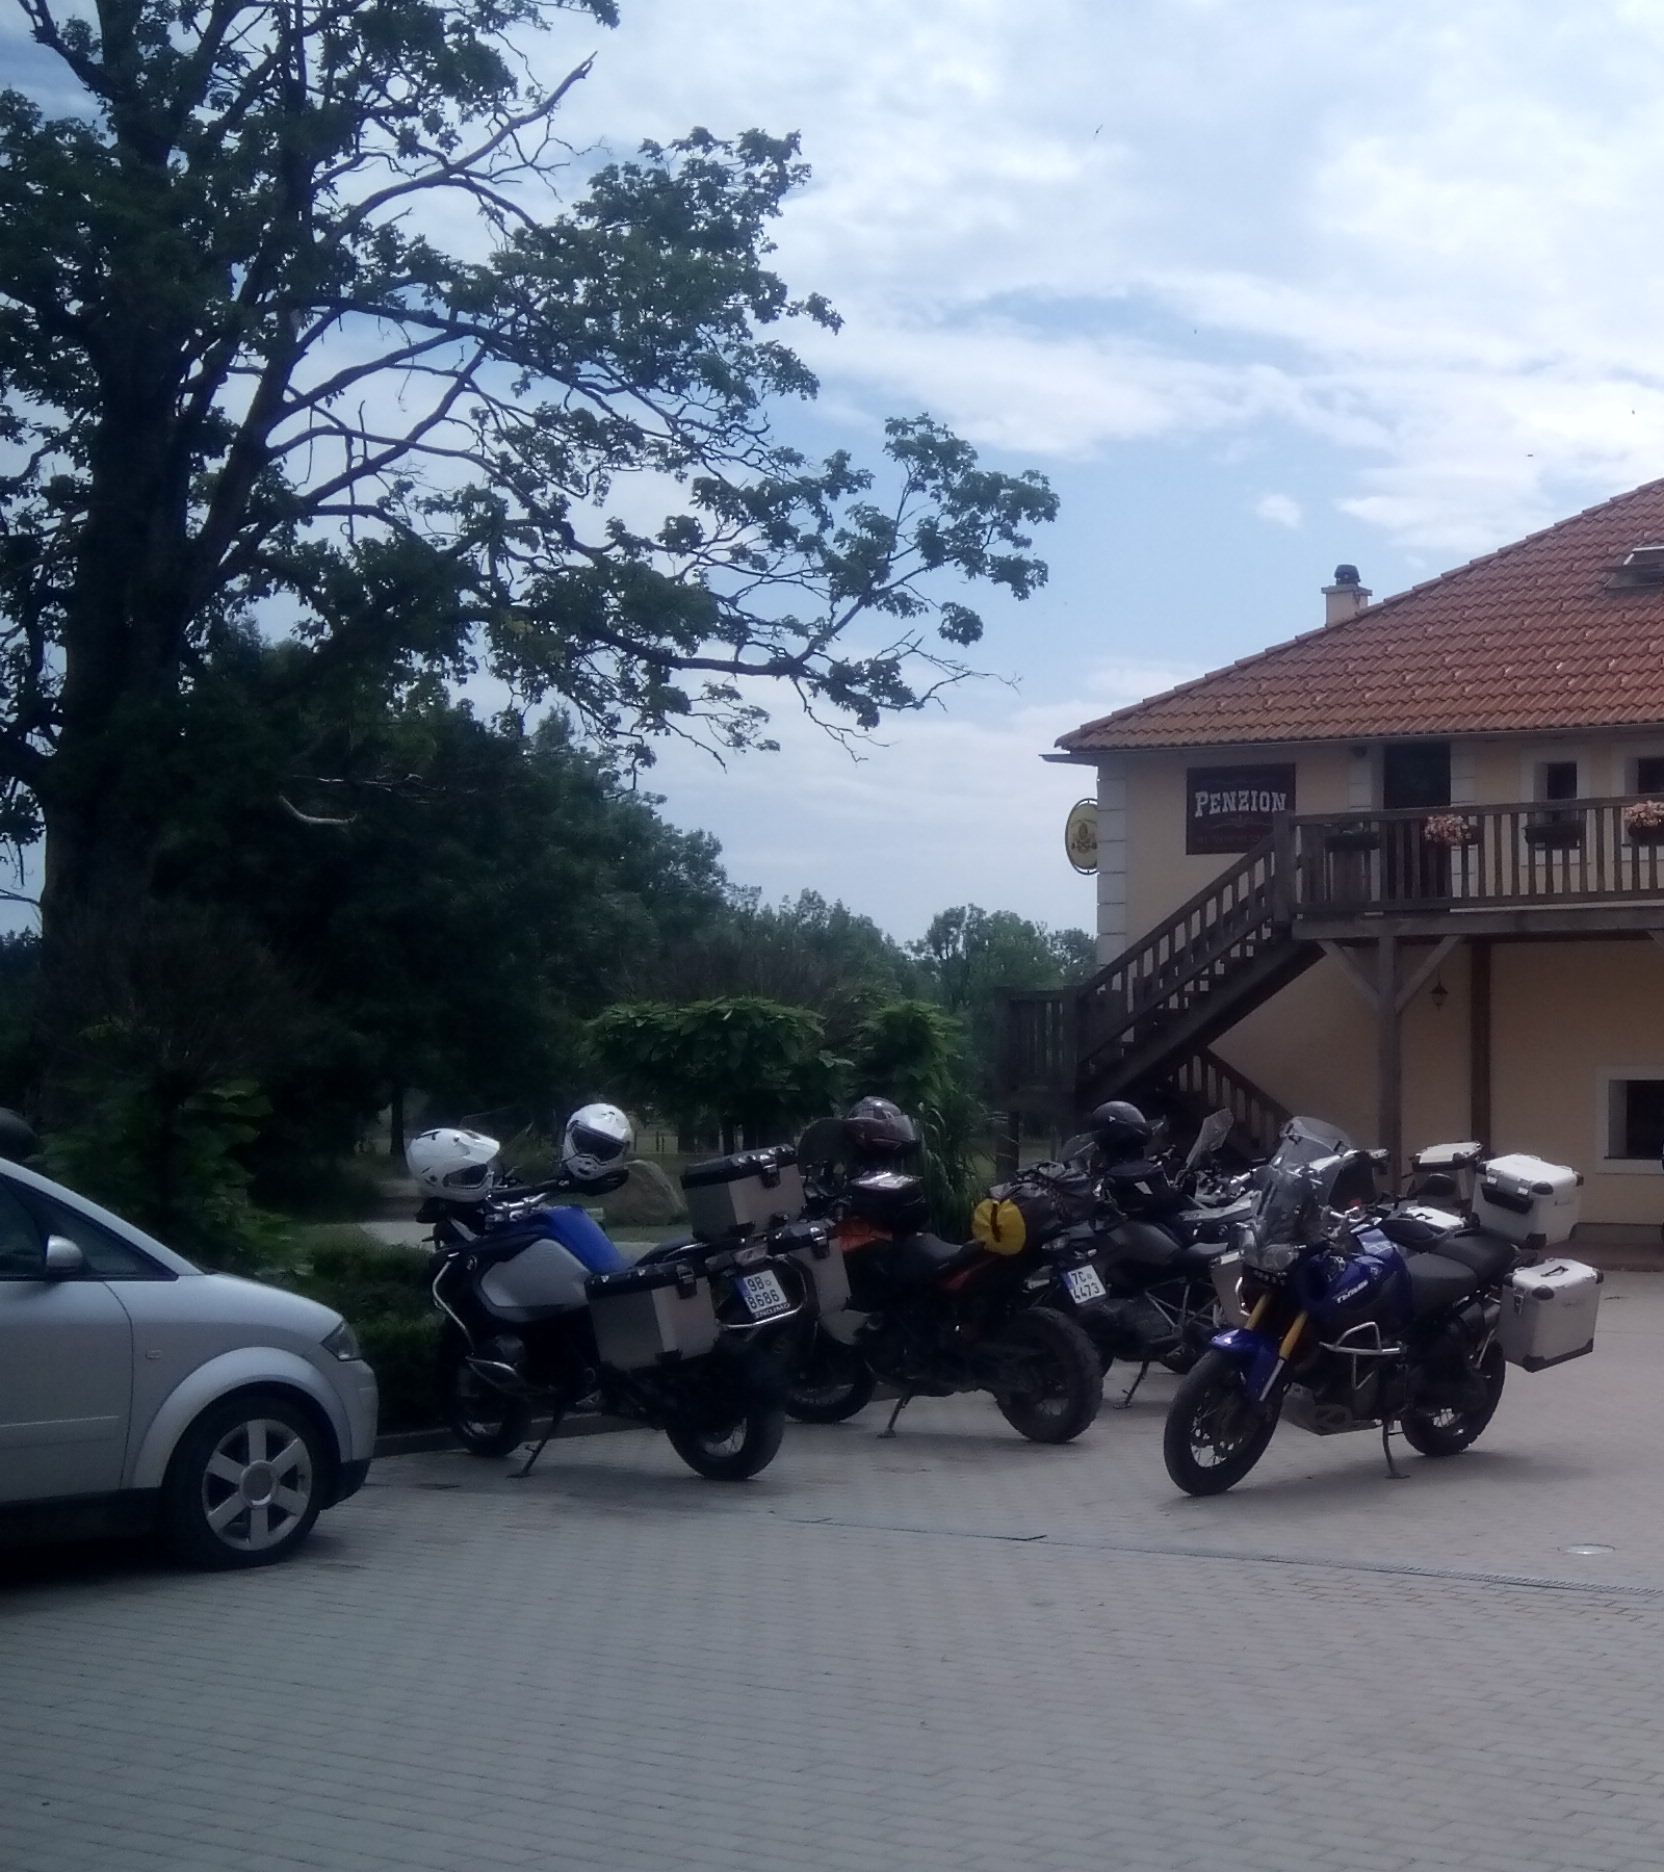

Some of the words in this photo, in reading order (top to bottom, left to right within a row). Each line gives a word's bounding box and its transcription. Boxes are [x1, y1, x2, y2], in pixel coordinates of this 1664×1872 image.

[1194, 789, 1287, 818] PENZION
[747, 1275, 765, 1292] 9B
[1071, 1271, 1087, 1285] 7C
[748, 1288, 779, 1309] 8686
